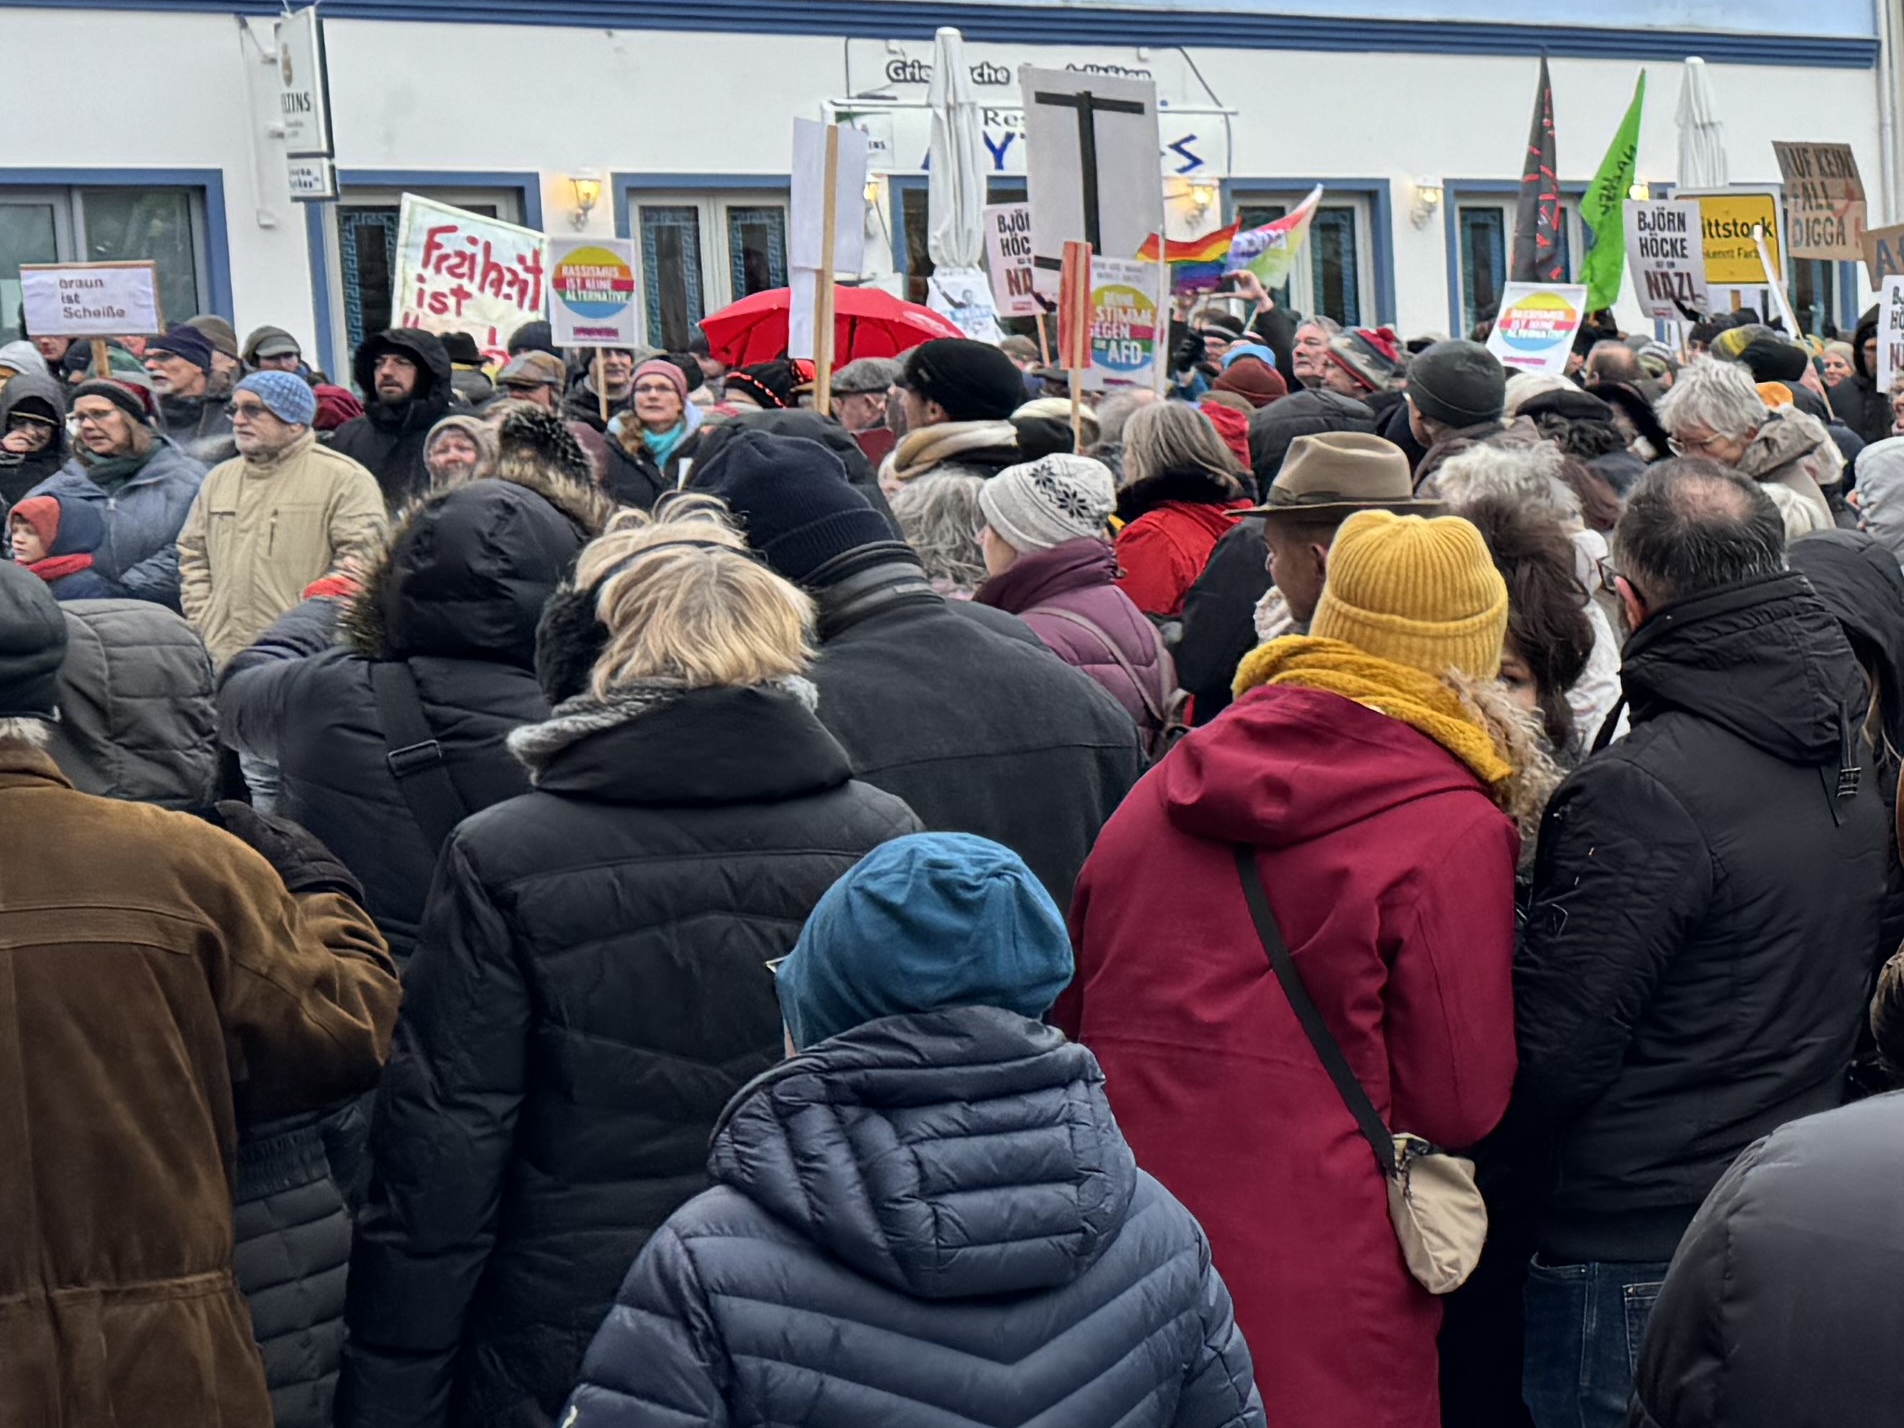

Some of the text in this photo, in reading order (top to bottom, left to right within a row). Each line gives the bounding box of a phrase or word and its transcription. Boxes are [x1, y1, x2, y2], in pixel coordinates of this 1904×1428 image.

[1637, 206, 1687, 232] BJÖRN
[1701, 216, 1774, 240] ittstok
[1792, 216, 1847, 248] DIGGA
[1639, 233, 1688, 259] HÖCKE
[61, 292, 81, 304] ist
[416, 274, 472, 317] ist
[1644, 270, 1696, 301] NAZI
[63, 306, 126, 319] Scheiße
[1107, 340, 1142, 365] AFD
